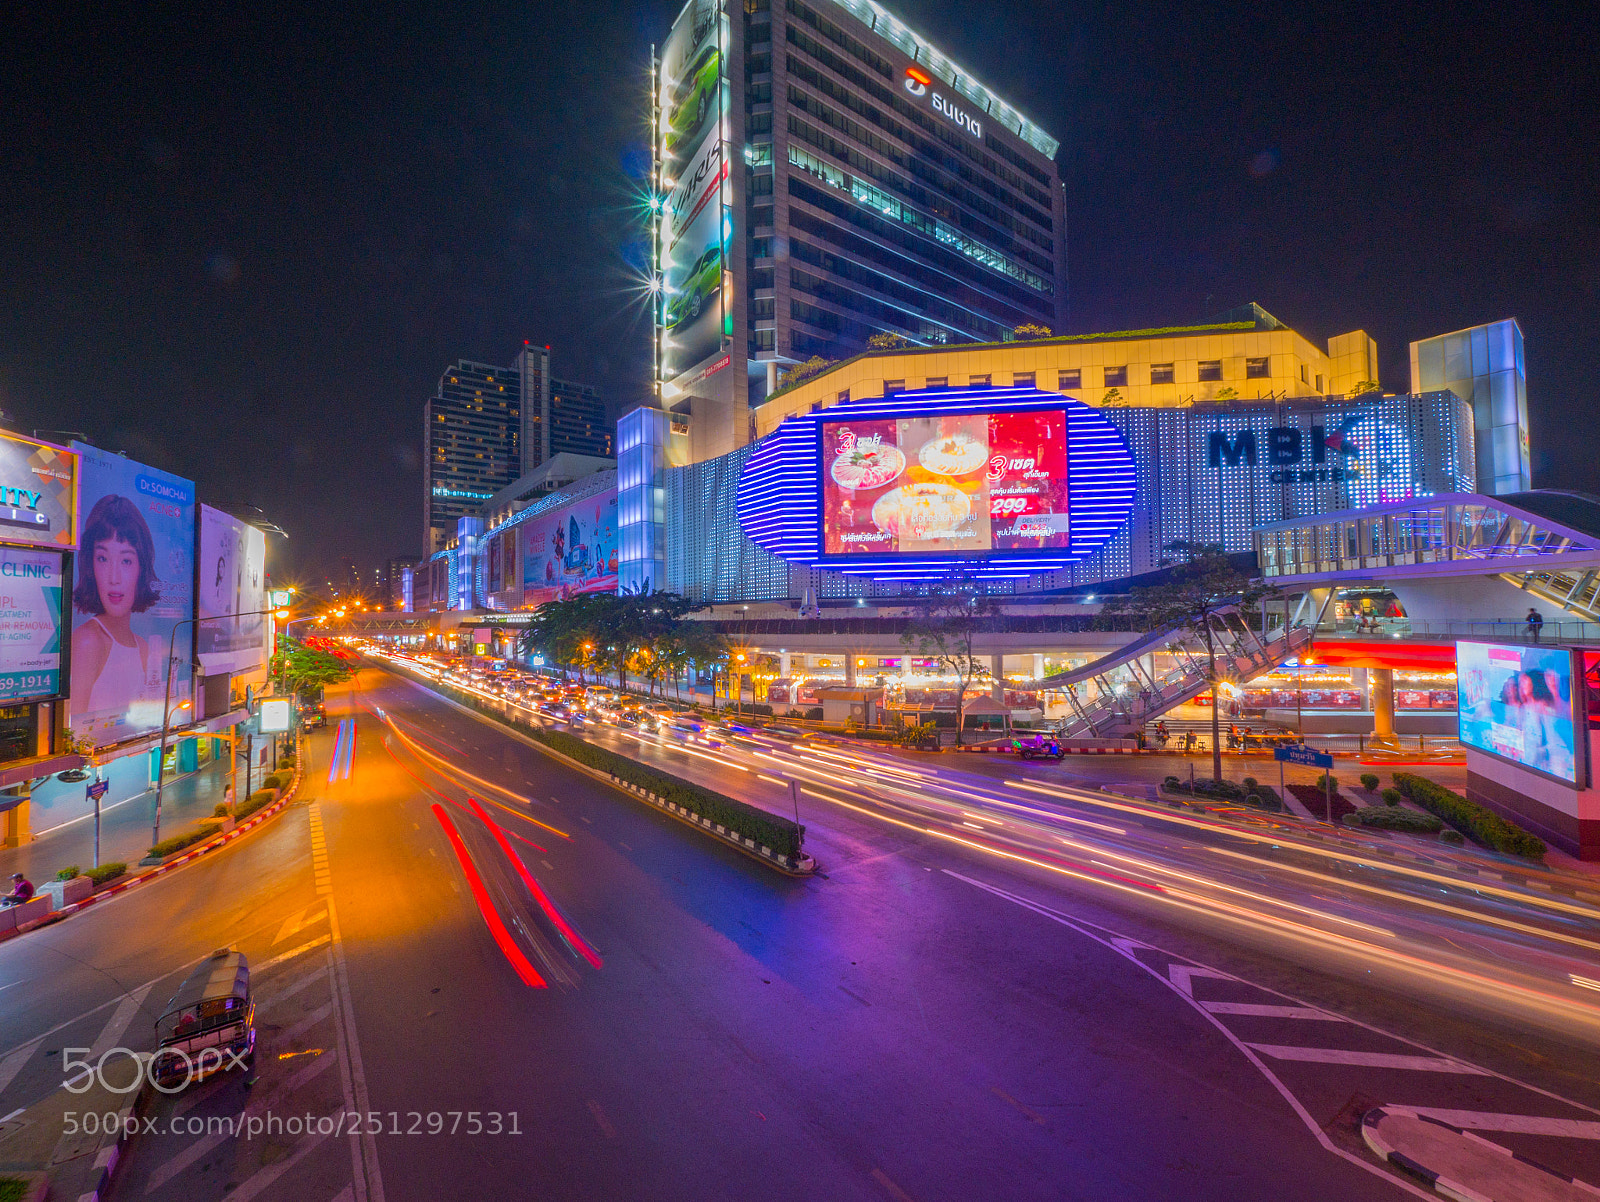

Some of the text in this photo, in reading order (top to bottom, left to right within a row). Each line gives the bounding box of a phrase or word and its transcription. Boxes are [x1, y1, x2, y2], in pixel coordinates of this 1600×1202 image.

[931, 92, 981, 139] ธนชาต
[1208, 415, 1366, 468] MBK
[986, 455, 1007, 480] 3
[149, 501, 173, 517] ACNE
[2, 562, 52, 579] CLINIC
[13, 620, 54, 631] REMOVAL
[1466, 683, 1485, 705] PLAY
